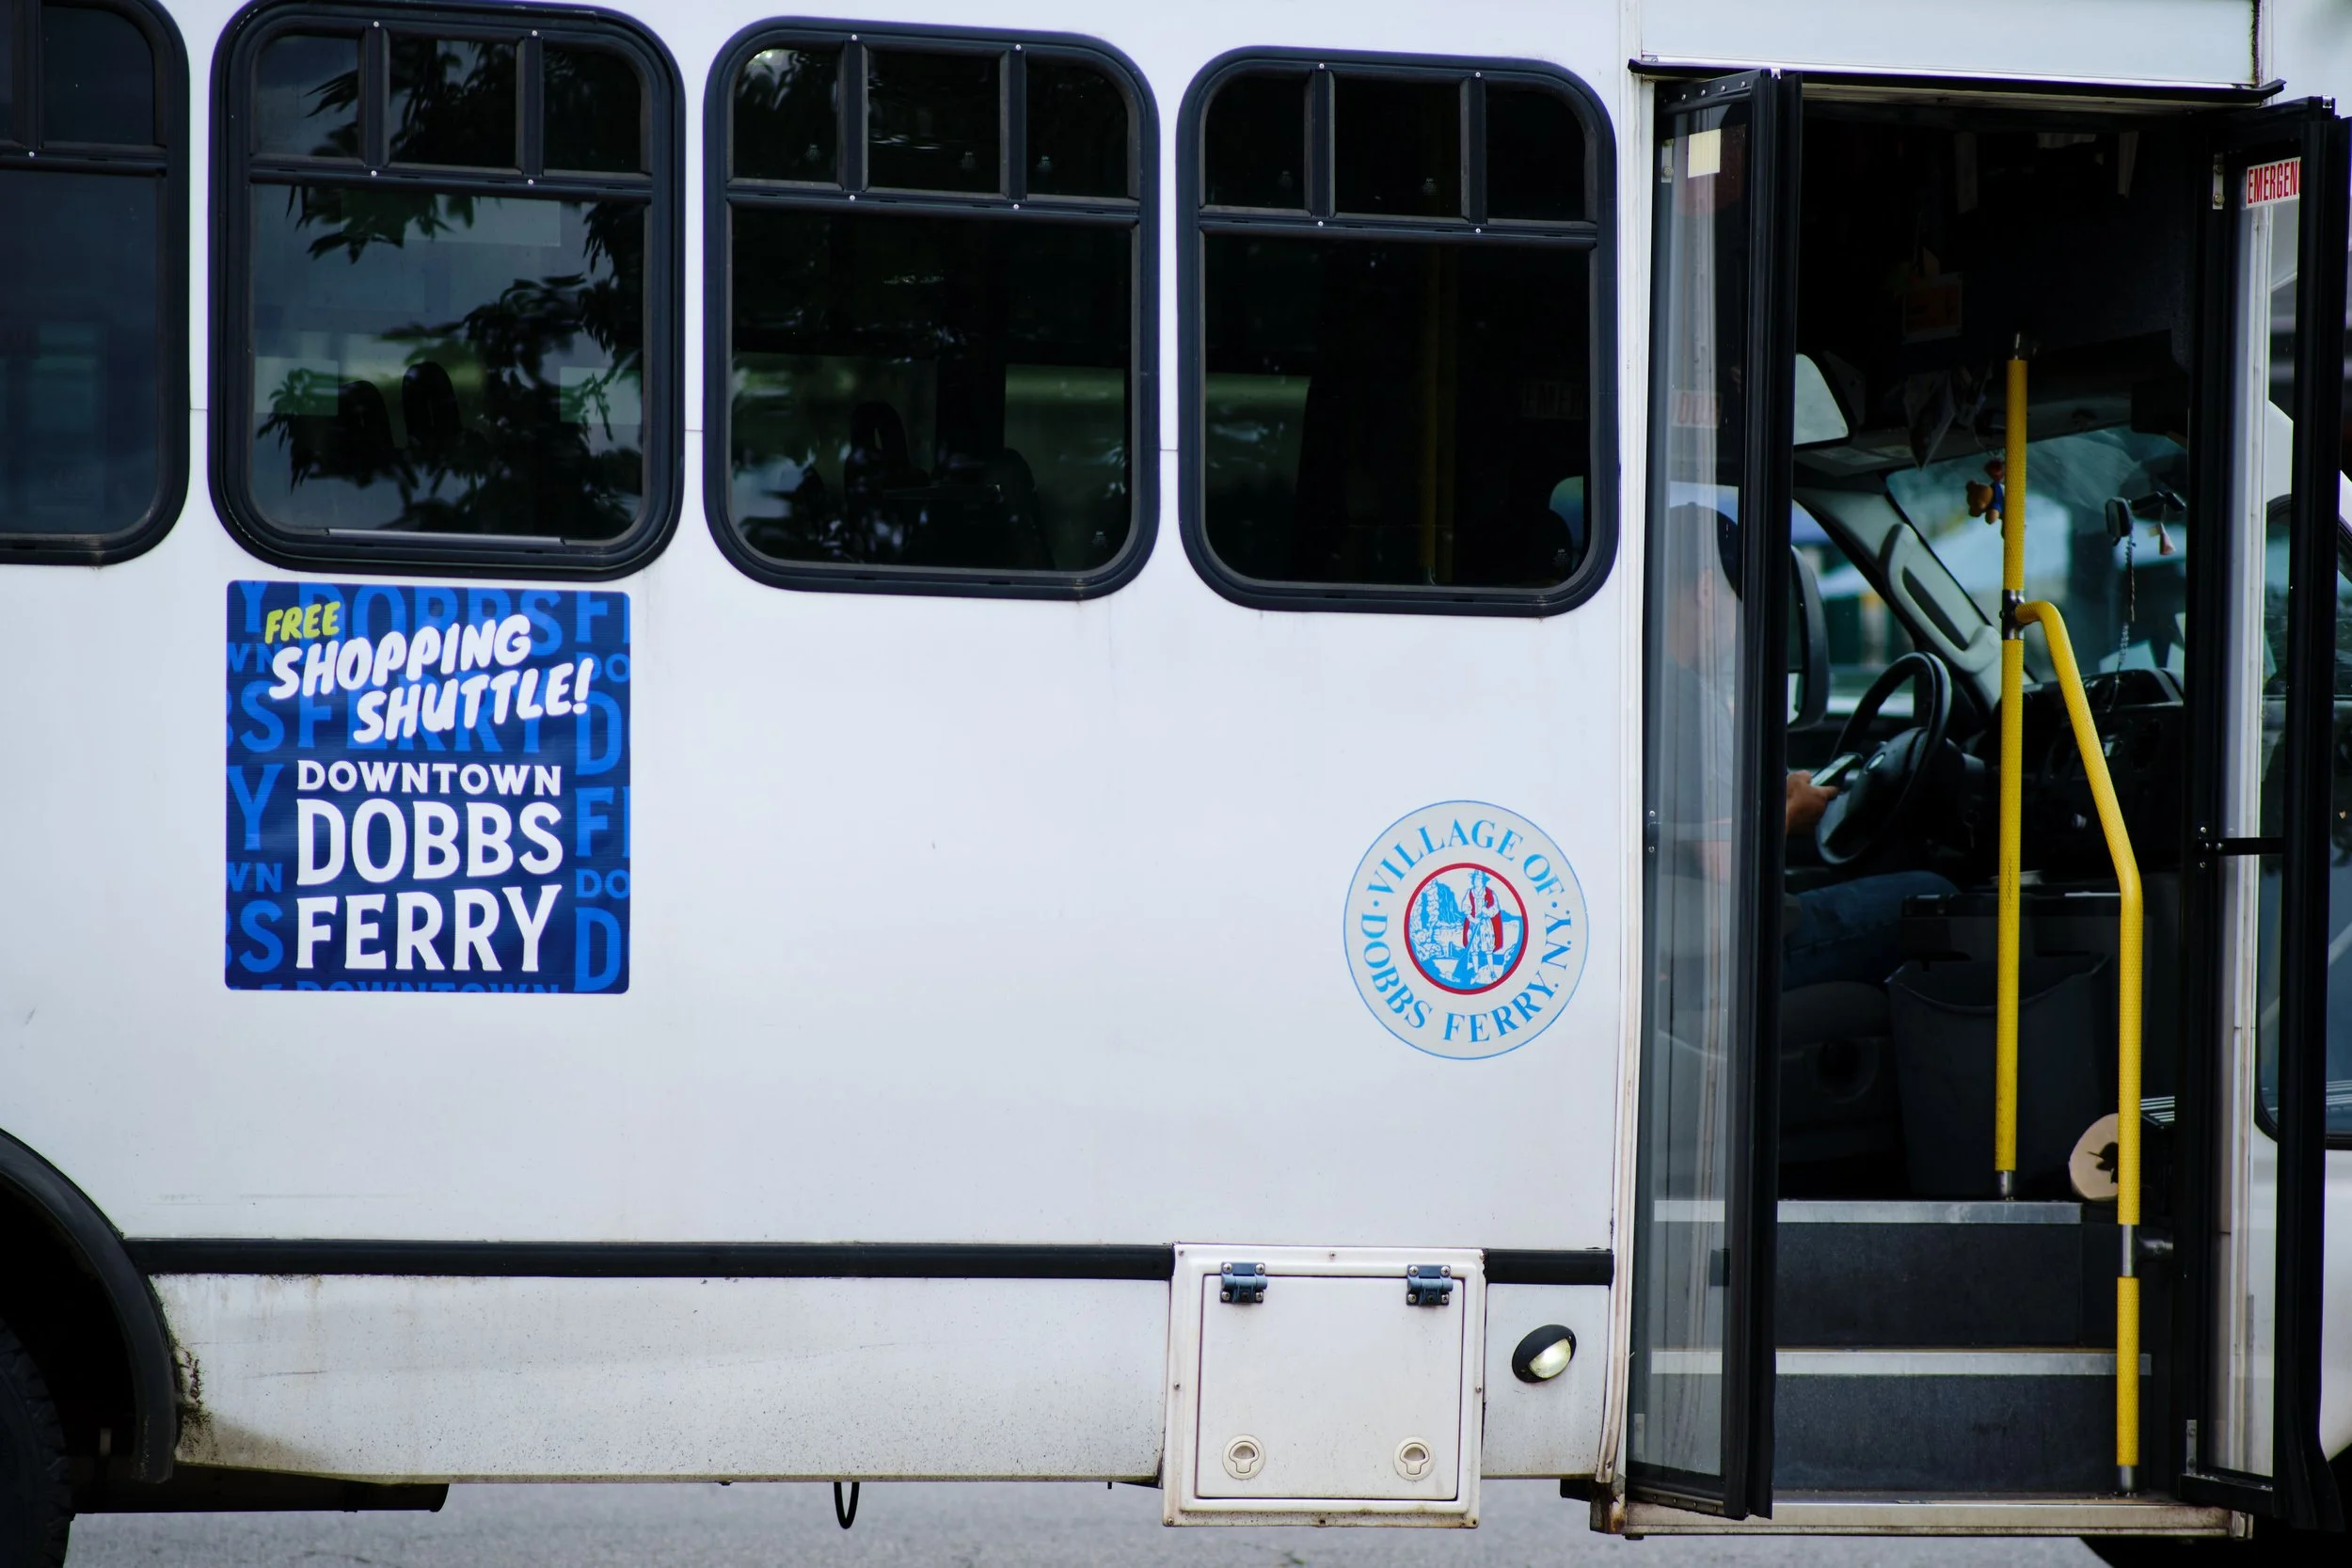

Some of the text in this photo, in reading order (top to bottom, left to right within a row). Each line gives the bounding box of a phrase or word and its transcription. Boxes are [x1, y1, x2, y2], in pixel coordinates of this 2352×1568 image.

[2248, 161, 2298, 204] EMERGEN
[265, 601, 342, 644] FREE
[269, 614, 532, 700] SHOPPING
[353, 657, 595, 743] SHUTTLE!
[297, 760, 562, 797] DOWNTOWN
[296, 799, 564, 886] DOBBS
[1367, 818, 1565, 896] VILLAGE OF
[295, 884, 563, 973] FERRY
[1360, 911, 1434, 1029] DOBBS
